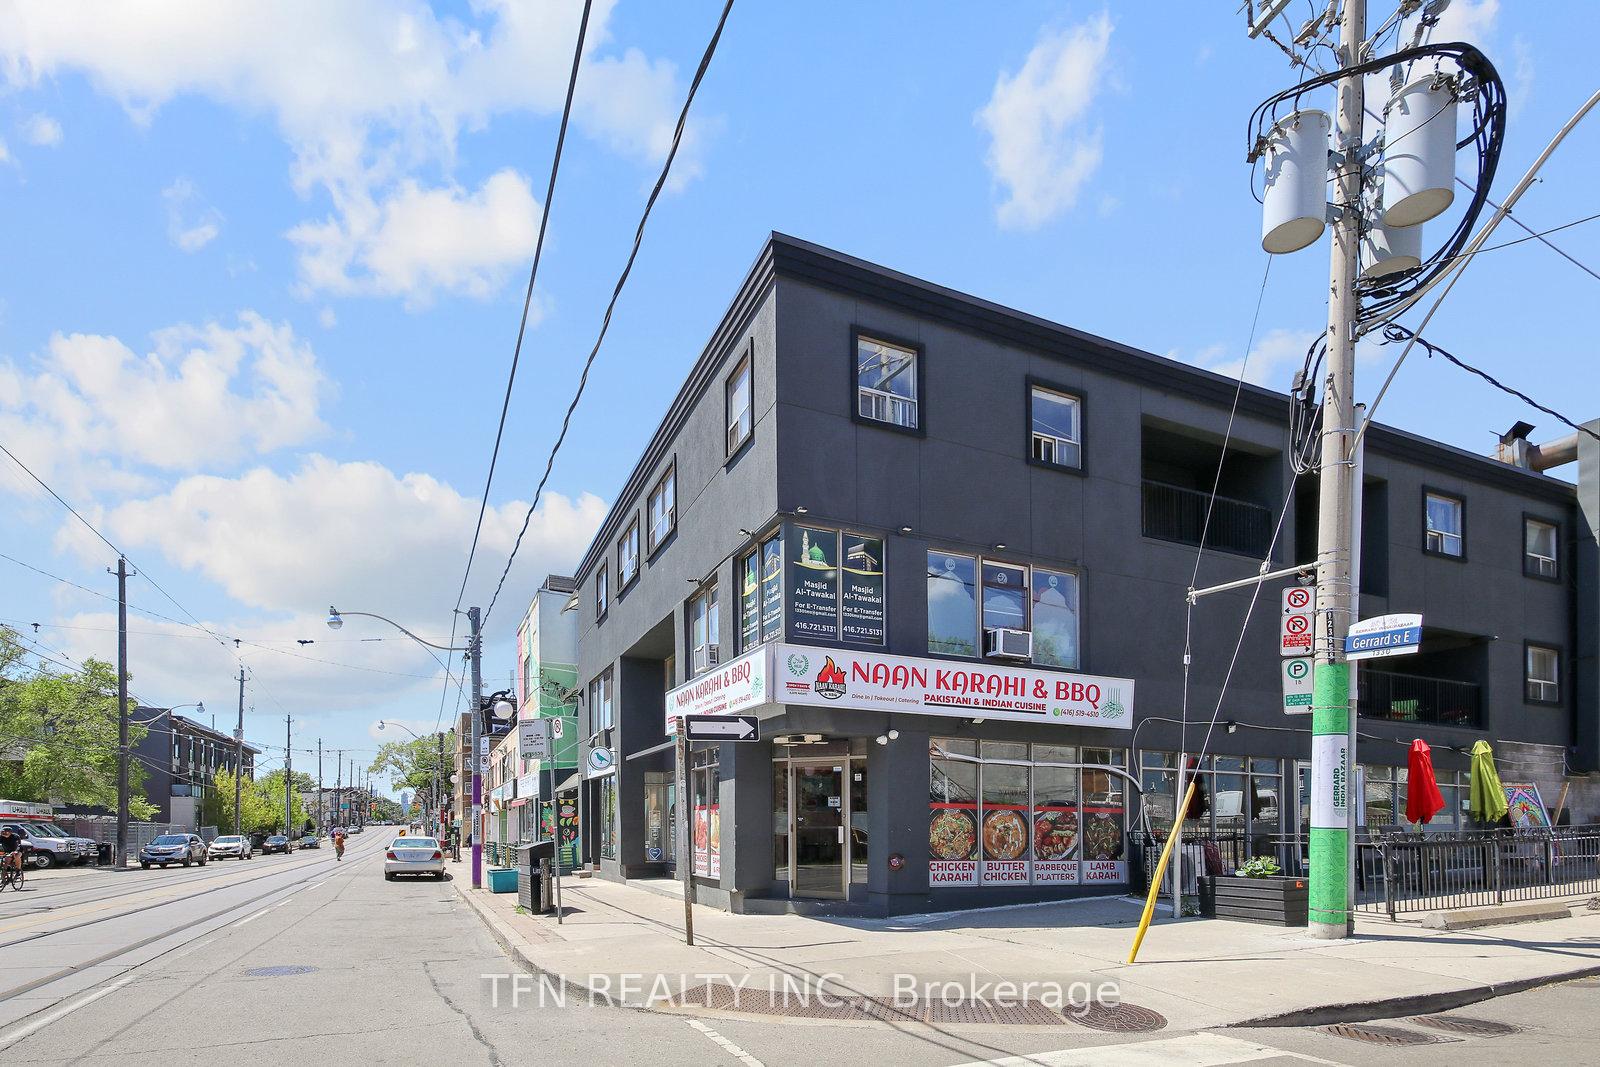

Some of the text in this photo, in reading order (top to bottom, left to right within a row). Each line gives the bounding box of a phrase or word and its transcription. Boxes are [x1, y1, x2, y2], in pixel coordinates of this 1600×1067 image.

[804, 580, 827, 590] Masjid
[852, 585, 874, 594] Masjid
[796, 588, 835, 599] Al-Tawakal
[844, 593, 882, 603] Al-Tawakal
[807, 603, 836, 612] E-Transfer
[854, 607, 882, 616] E-Transfer
[795, 622, 836, 632] 416.721.5131
[843, 626, 882, 636] 416.721.5131
[1353, 631, 1410, 649] Gerrard St E
[676, 661, 750, 707] NAAN KARAHI & BBQ
[852, 661, 1101, 710] NAAN KARAHI & BBQ
[924, 694, 971, 705] PAKISTANI
[982, 699, 1013, 708] INDIAN
[1014, 701, 1046, 710] CUISINE
[1060, 708, 1099, 718] (416) 519-4510
[929, 863, 975, 872] CHICKEN
[987, 862, 1025, 871] BUTTER
[933, 873, 972, 882] KARAHI
[983, 872, 1027, 881] CHICKEN
[1086, 872, 1120, 880] KARAHI
